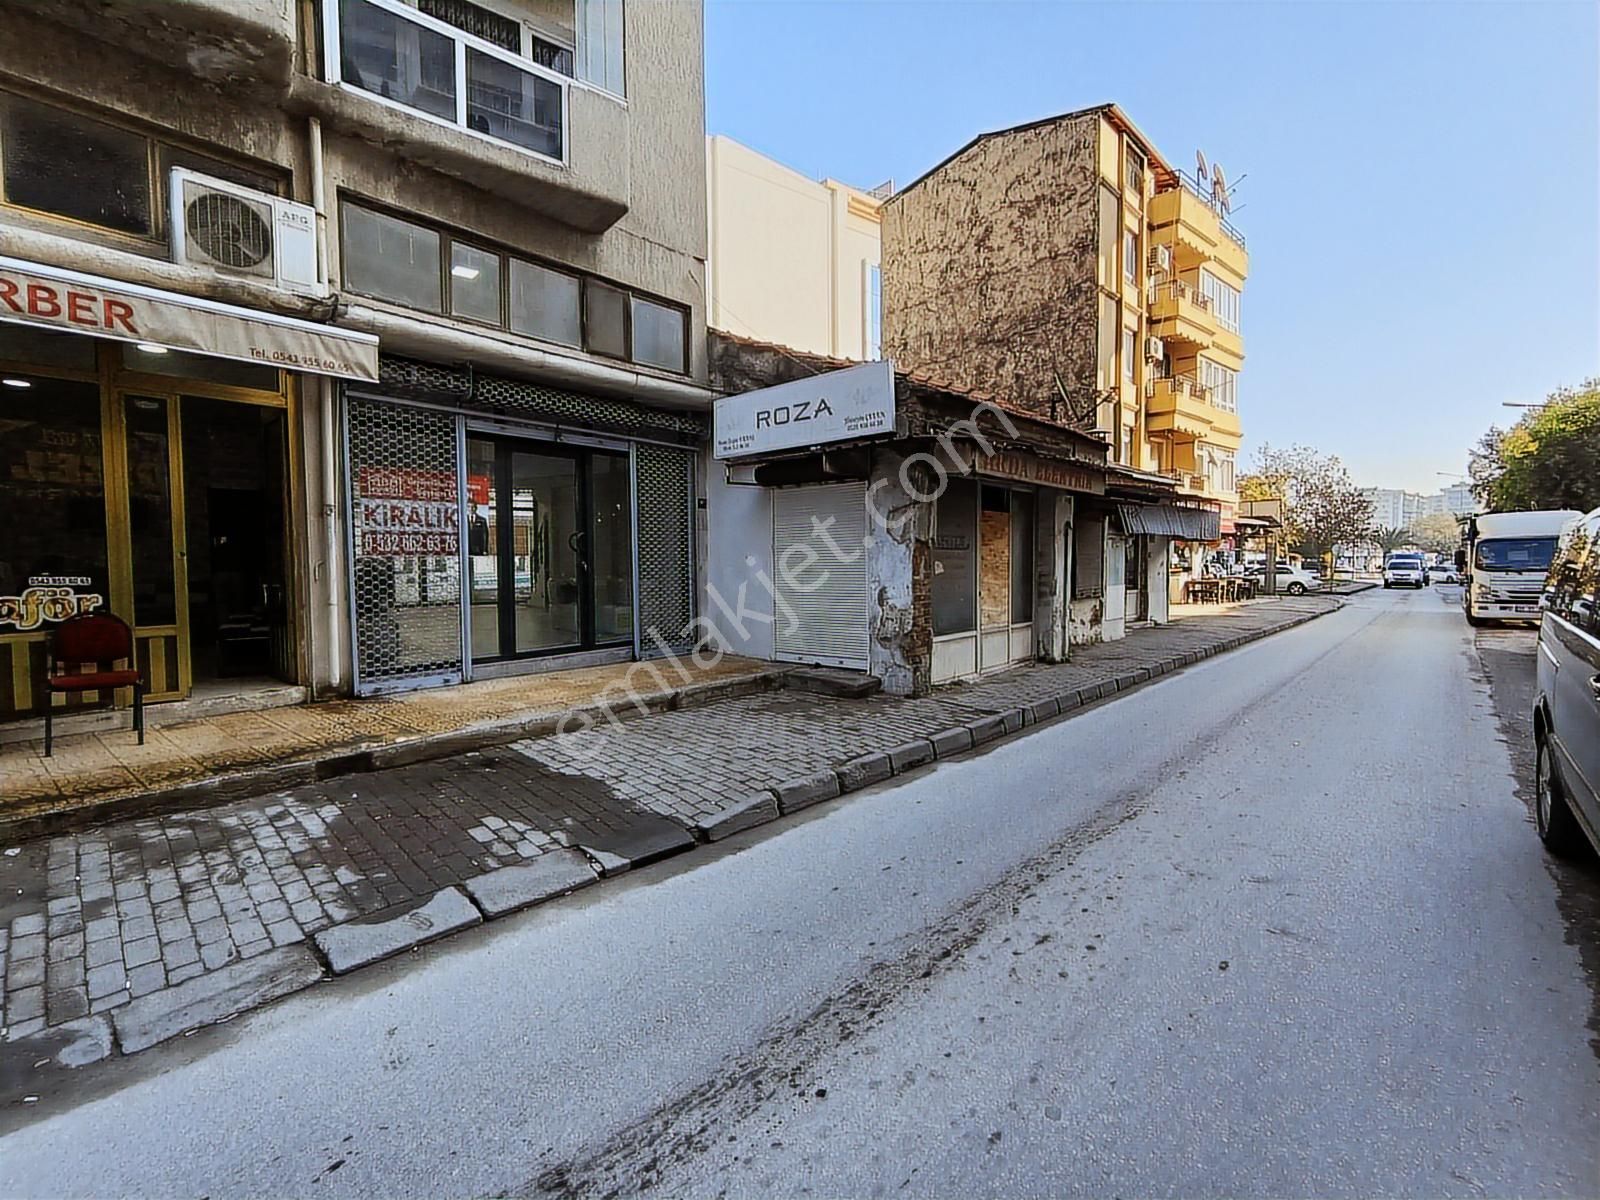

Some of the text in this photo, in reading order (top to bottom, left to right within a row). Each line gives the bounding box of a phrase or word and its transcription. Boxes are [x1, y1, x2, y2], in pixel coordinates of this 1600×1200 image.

[249, 347, 269, 359] Tel.
[272, 351, 298, 363] 0543
[756, 398, 833, 430] ROZA
[364, 503, 458, 528] KIRALIK
